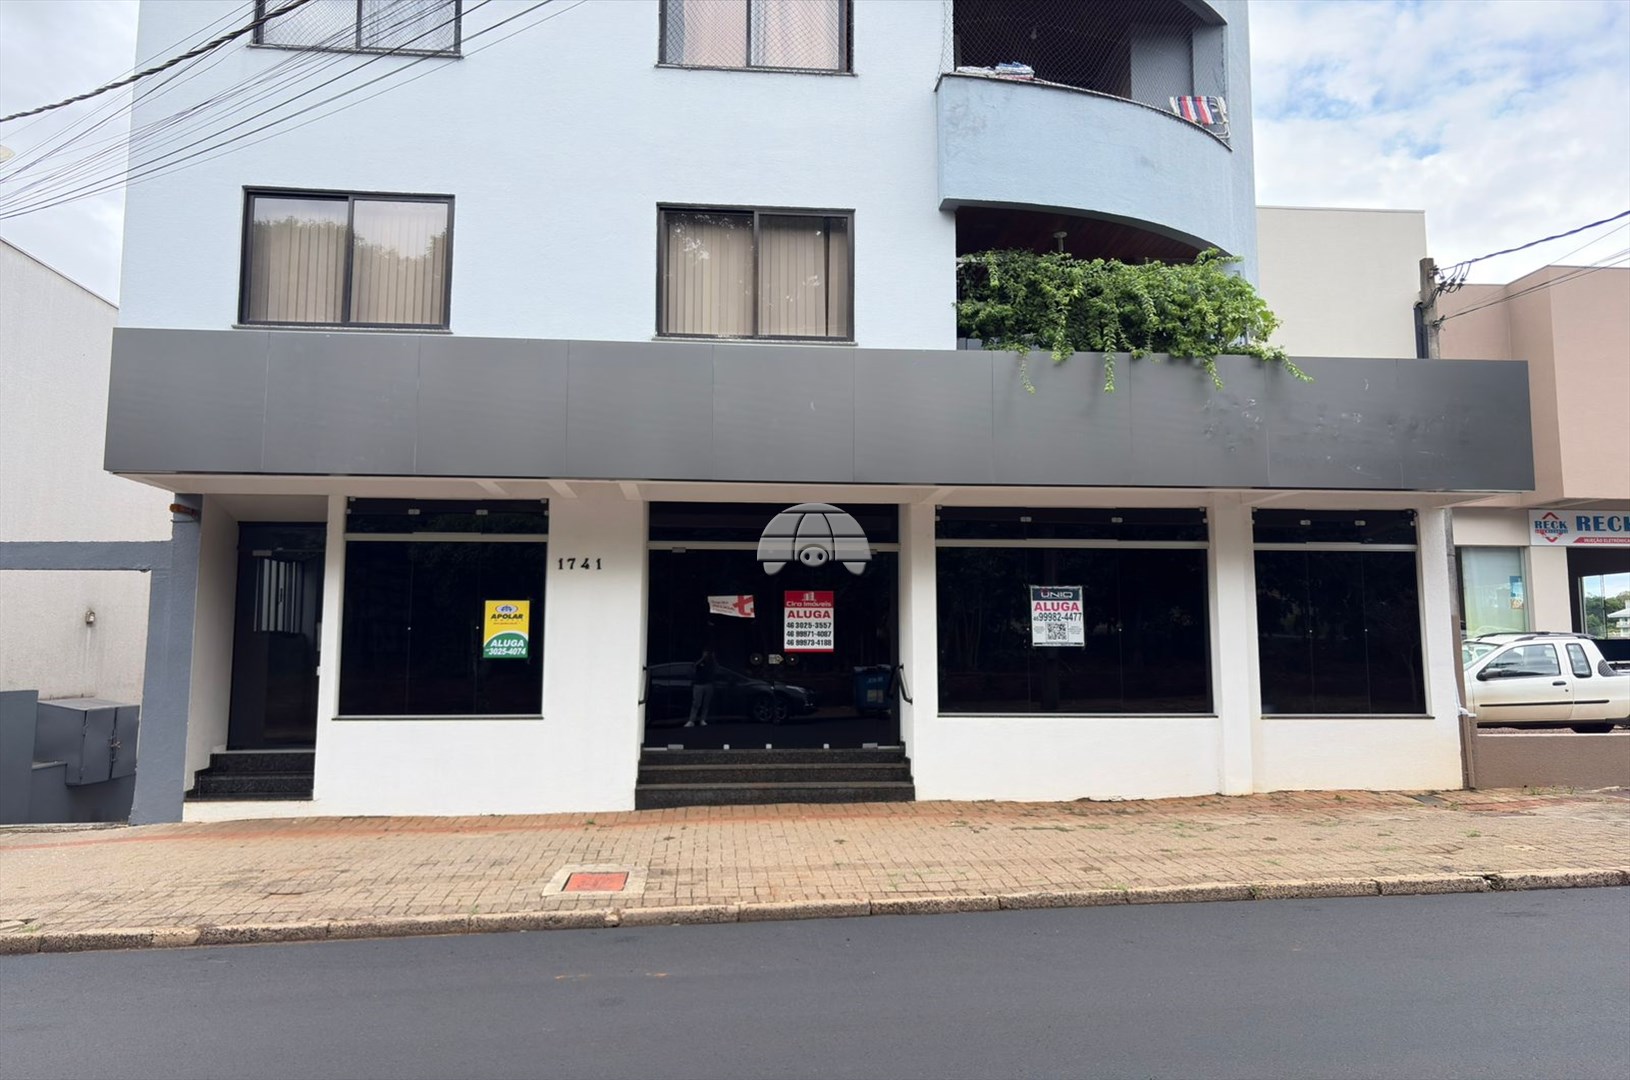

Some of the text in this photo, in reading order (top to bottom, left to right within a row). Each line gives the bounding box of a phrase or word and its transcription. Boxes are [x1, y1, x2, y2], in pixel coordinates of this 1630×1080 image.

[1534, 520, 1567, 529] RECK
[558, 558, 602, 570] 1741
[1034, 602, 1079, 612] ALUGA
[787, 610, 831, 619] ALUGA
[1038, 612, 1082, 621] 99982-4477
[488, 647, 527, 655] 3025-4074
